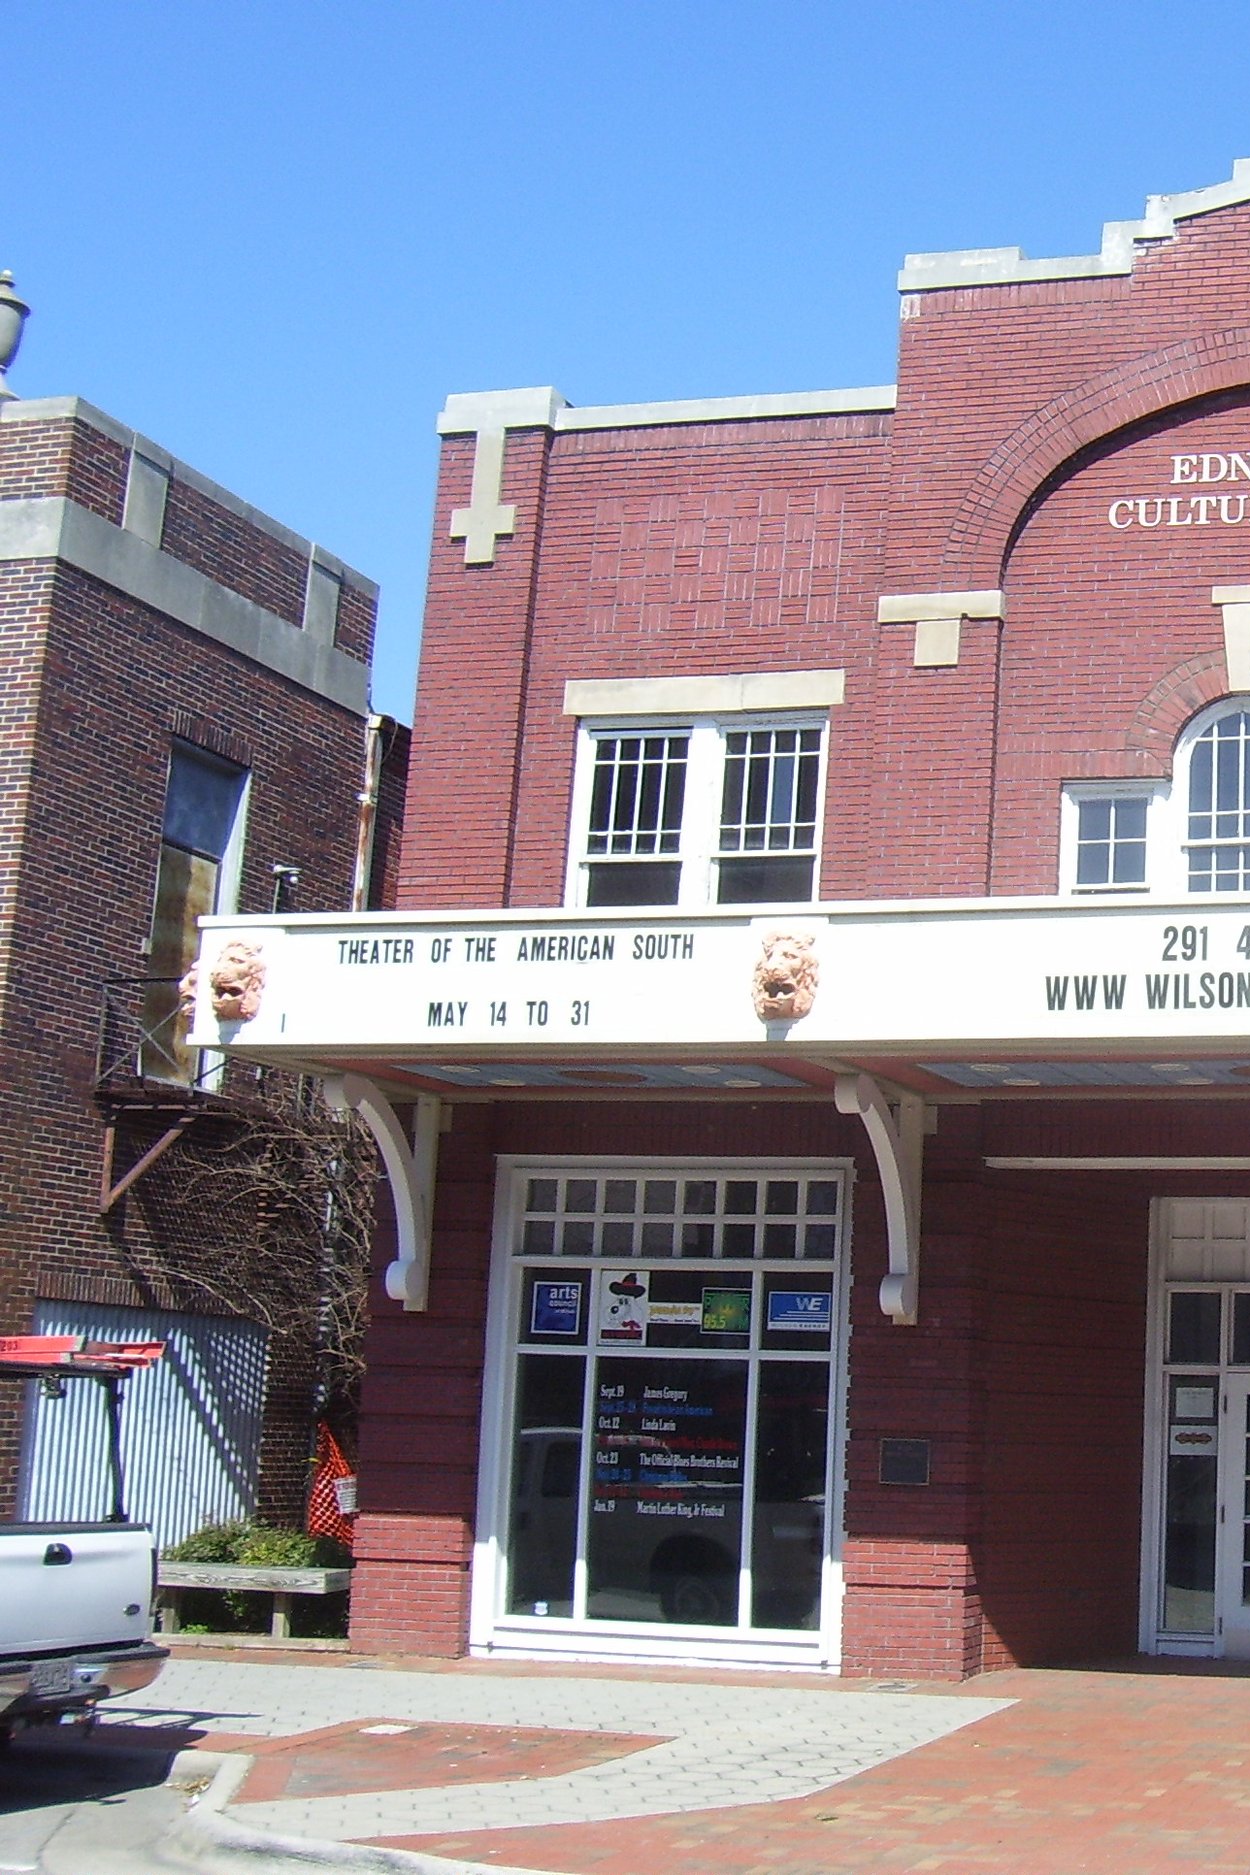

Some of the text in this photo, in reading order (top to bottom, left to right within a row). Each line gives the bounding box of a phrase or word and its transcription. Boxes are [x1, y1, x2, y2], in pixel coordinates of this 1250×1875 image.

[338, 933, 694, 965] THEATER OF THE AMERICAN SOUTH
[1162, 925, 1208, 961] 291
[1046, 974, 1127, 1011] WWW
[428, 1000, 590, 1027] MAY 14 TO 31
[549, 1286, 579, 1300] arts
[549, 1300, 577, 1308] council
[795, 1297, 823, 1311] WE
[704, 1314, 726, 1330] 95.5
[663, 1386, 688, 1402] Gregory
[639, 1452, 651, 1465] The
